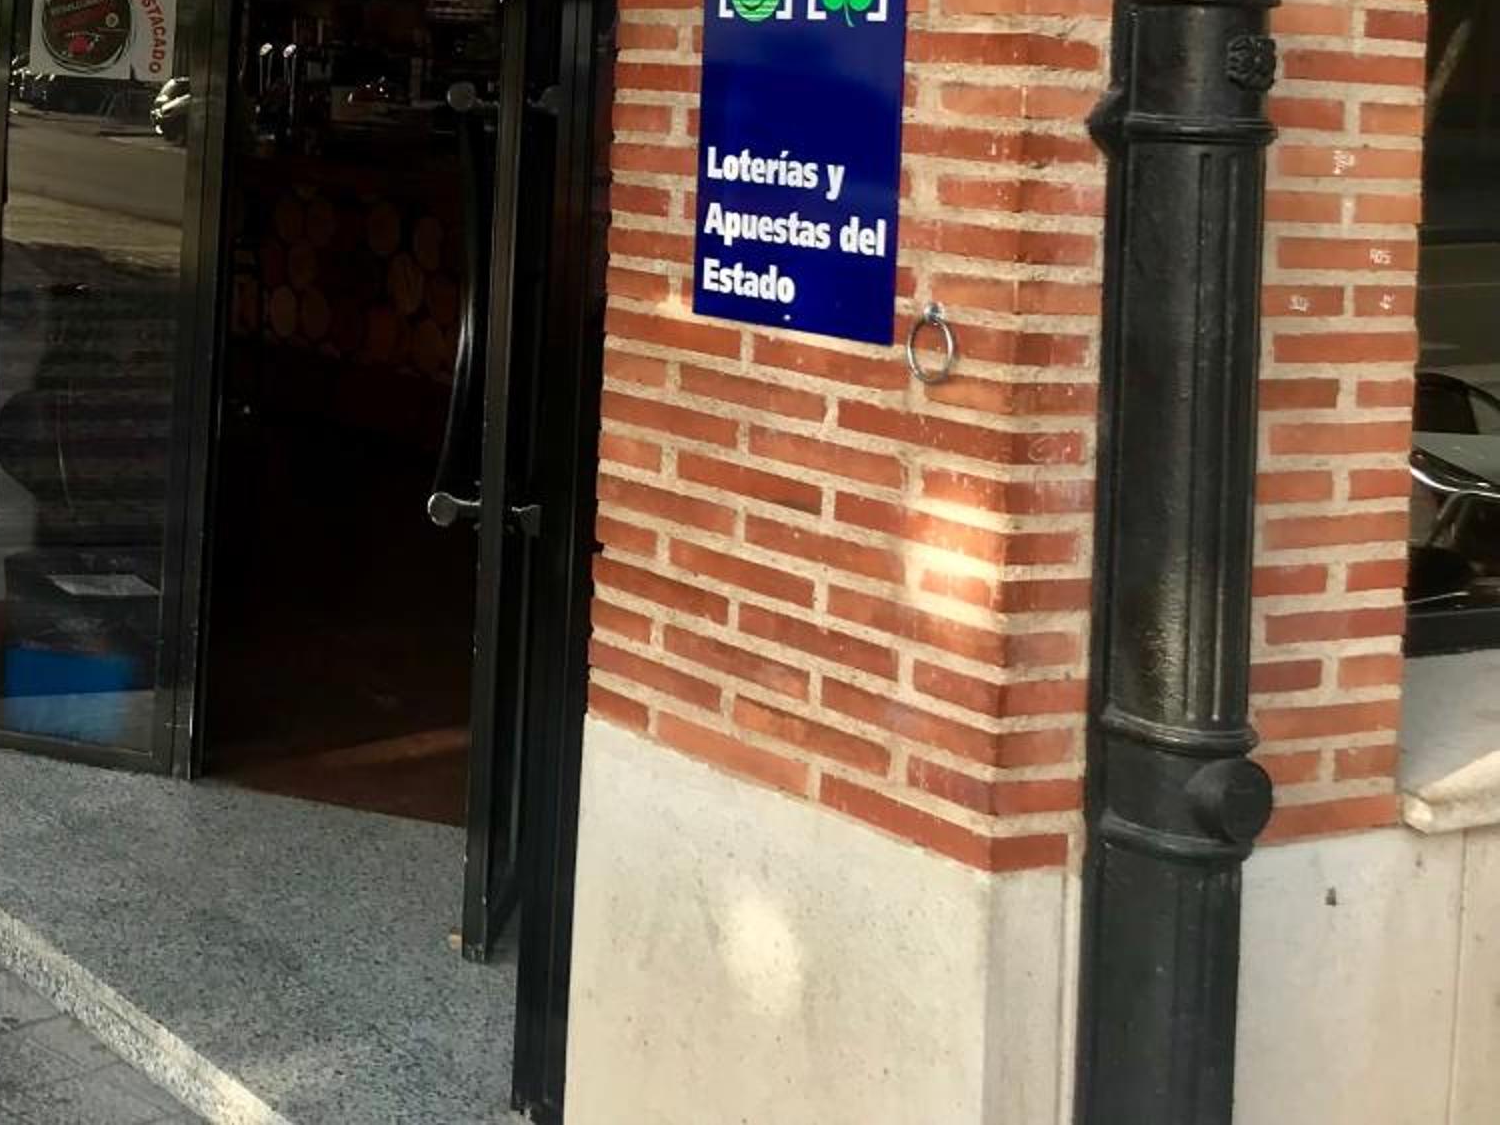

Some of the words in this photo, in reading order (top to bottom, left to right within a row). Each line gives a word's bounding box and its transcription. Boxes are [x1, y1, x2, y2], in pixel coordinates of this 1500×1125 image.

[707, 146, 819, 189] Loterías
[826, 164, 845, 201] y
[704, 202, 831, 250] Apuestas
[839, 216, 887, 257] del
[703, 257, 795, 304] Estado
